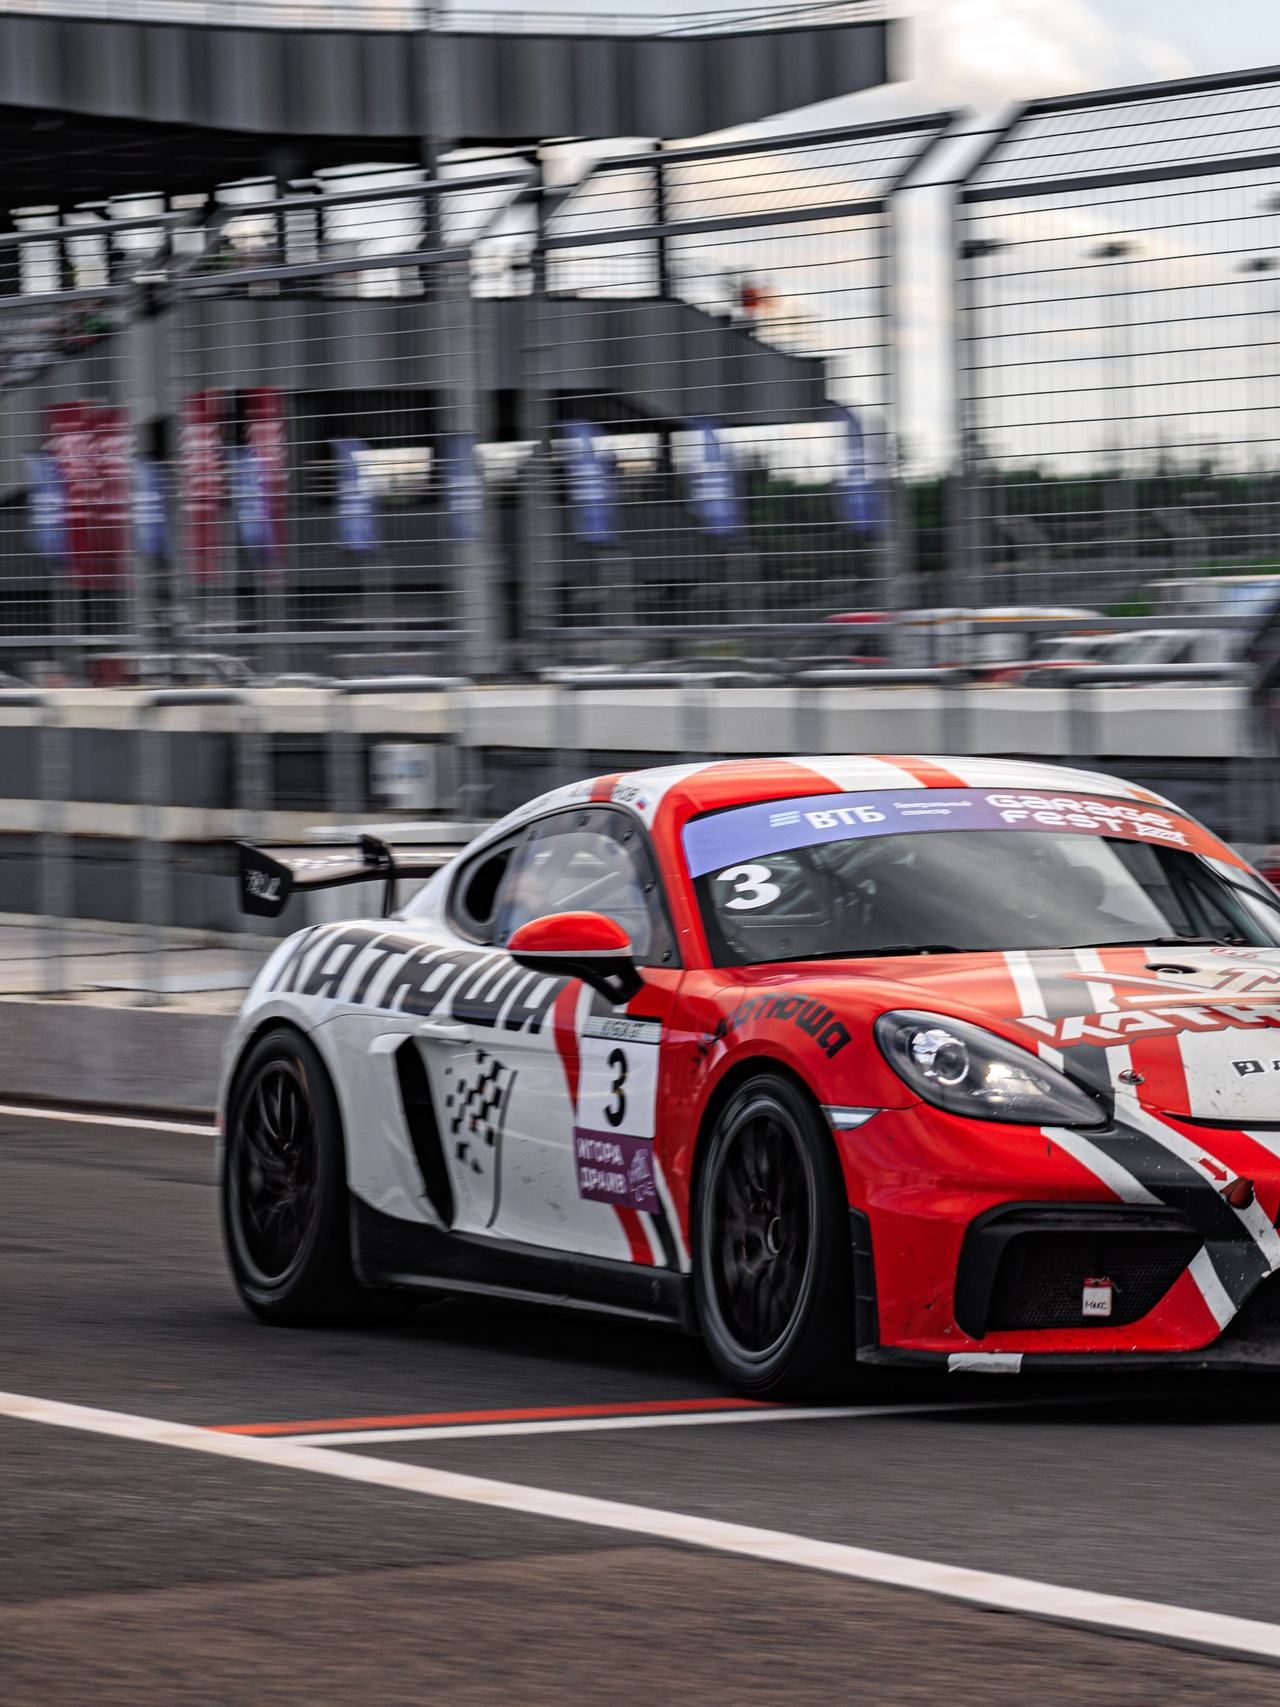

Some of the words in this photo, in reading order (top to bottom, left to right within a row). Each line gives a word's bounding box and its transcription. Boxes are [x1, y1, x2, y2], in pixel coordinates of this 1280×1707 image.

[803, 805, 886, 829] ВТБ
[715, 864, 781, 910] 3
[604, 1048, 628, 1128] 3
